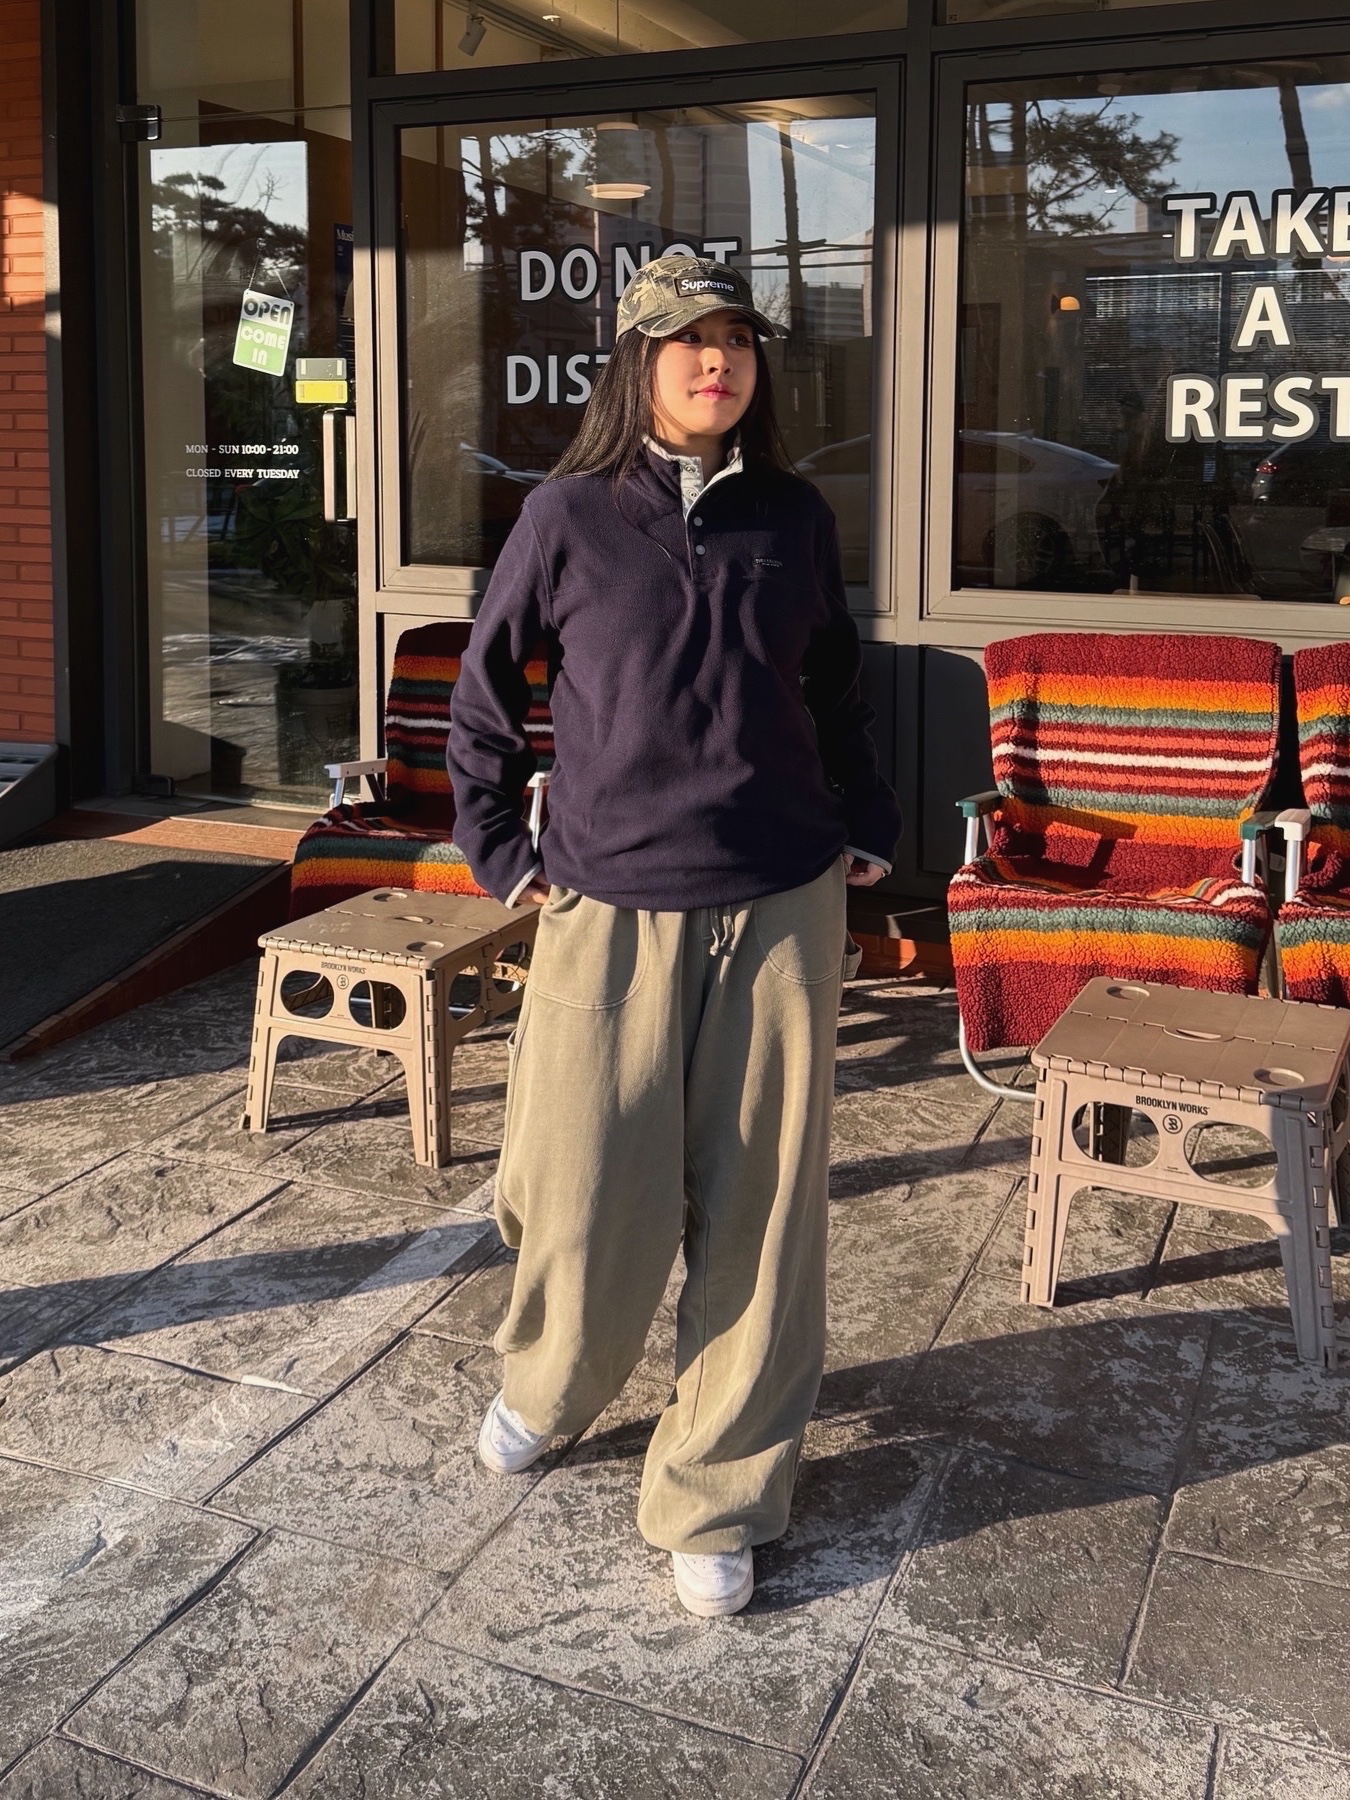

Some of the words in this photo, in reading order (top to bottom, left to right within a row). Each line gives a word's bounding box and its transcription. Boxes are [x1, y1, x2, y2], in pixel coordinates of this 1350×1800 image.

[519, 247, 598, 301] DO
[614, 241, 738, 299] NT
[681, 279, 734, 291] Supreme
[243, 298, 291, 325] OPEN
[1236, 285, 1291, 347] A
[240, 325, 286, 350] COME
[251, 348, 268, 366] IN
[506, 353, 611, 405] DIS
[1171, 376, 1350, 438] REST
[185, 444, 208, 454] MON
[218, 444, 240, 454] SUN
[185, 468, 221, 478] CLOSED
[224, 468, 255, 478] EVERY
[256, 468, 300, 479] TUESDAY
[320, 961, 347, 972] BROOKLYN
[347, 965, 366, 974] WORKS
[1135, 1095, 1178, 1111] BROOKLYN
[1178, 1102, 1209, 1116] WORKS
